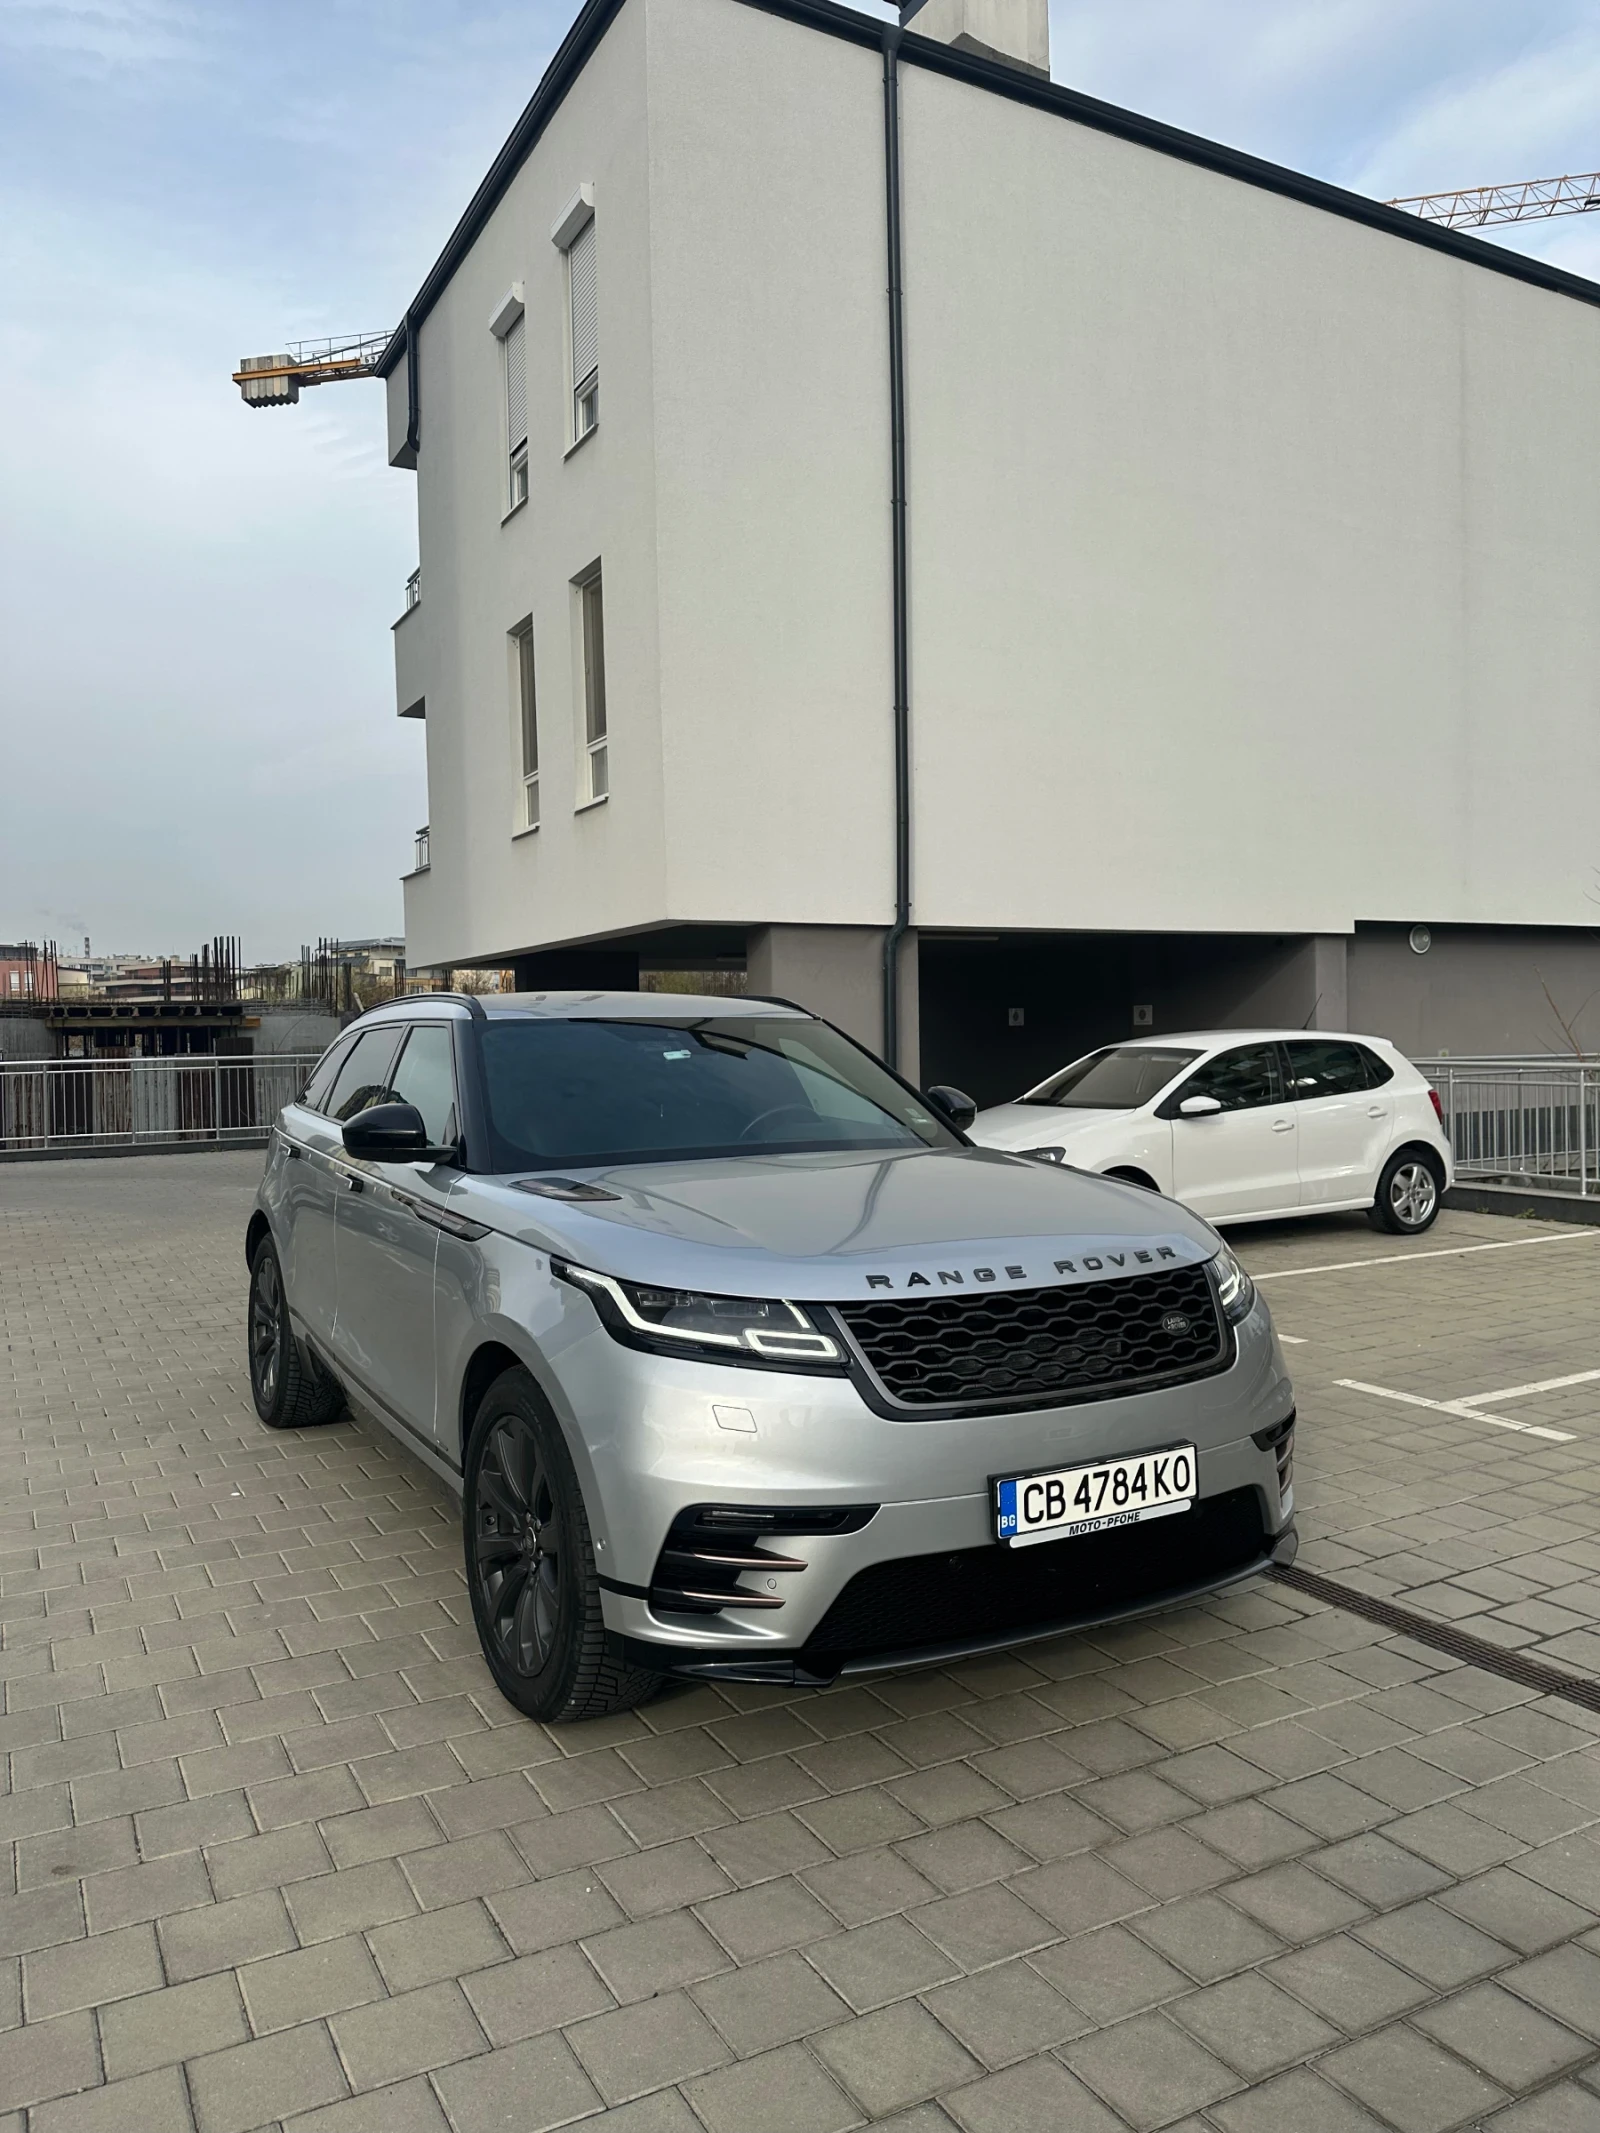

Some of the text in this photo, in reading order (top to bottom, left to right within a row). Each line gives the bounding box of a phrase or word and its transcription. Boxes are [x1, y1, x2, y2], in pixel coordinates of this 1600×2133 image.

[865, 1246, 1177, 1289] RANGE ROVER
[1023, 1455, 1191, 1524] CB 4784 KO
[1001, 1514, 1016, 1528] BG
[1068, 1511, 1141, 1536] MOTO-PFOHE
